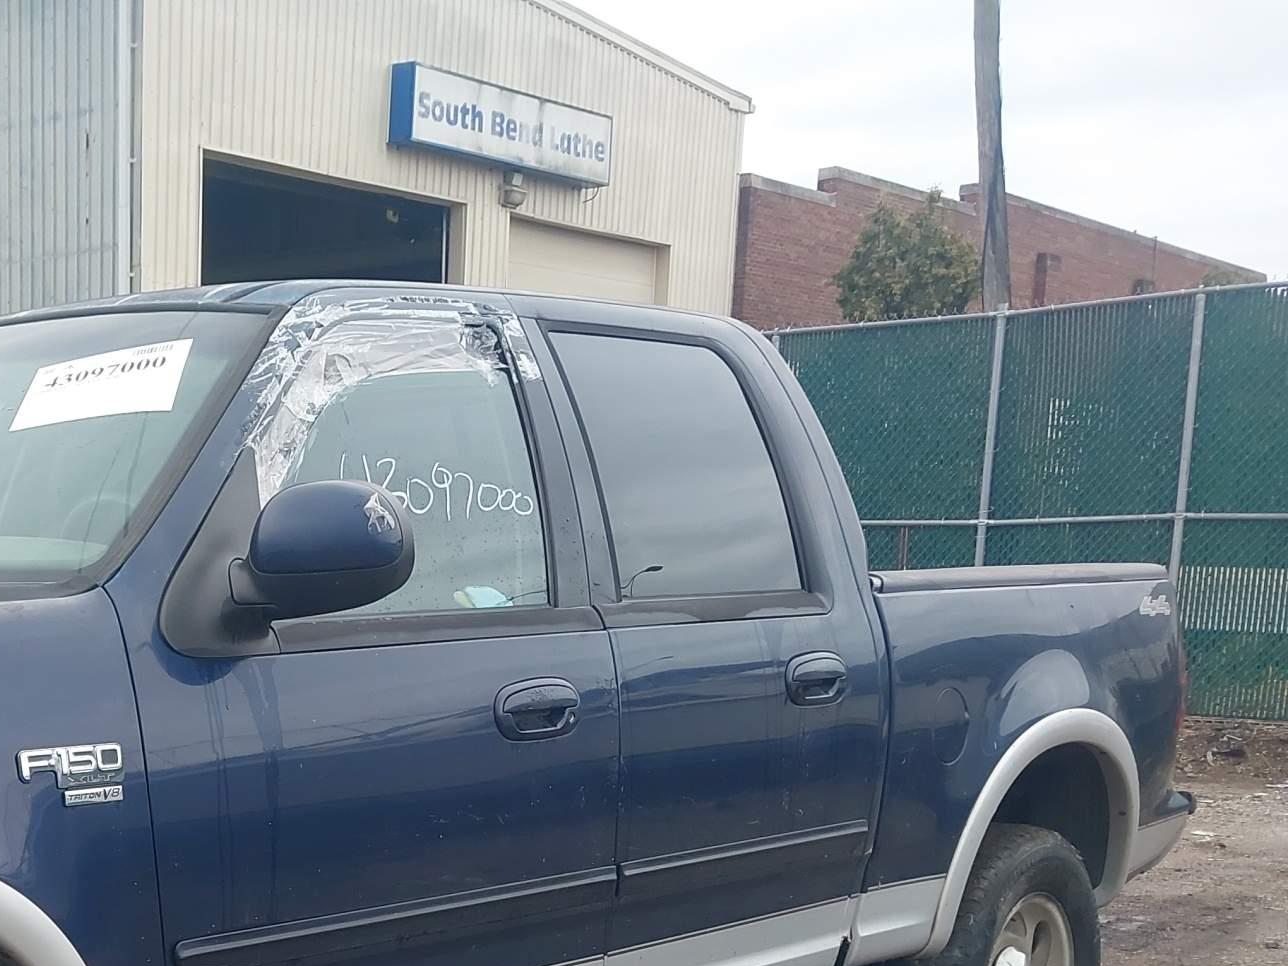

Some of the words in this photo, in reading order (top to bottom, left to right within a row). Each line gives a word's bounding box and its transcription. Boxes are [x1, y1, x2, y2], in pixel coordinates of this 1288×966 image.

[417, 92, 484, 133] South
[490, 110, 544, 147] Bend
[550, 125, 606, 162] Lathe
[44, 355, 167, 389] 43097000
